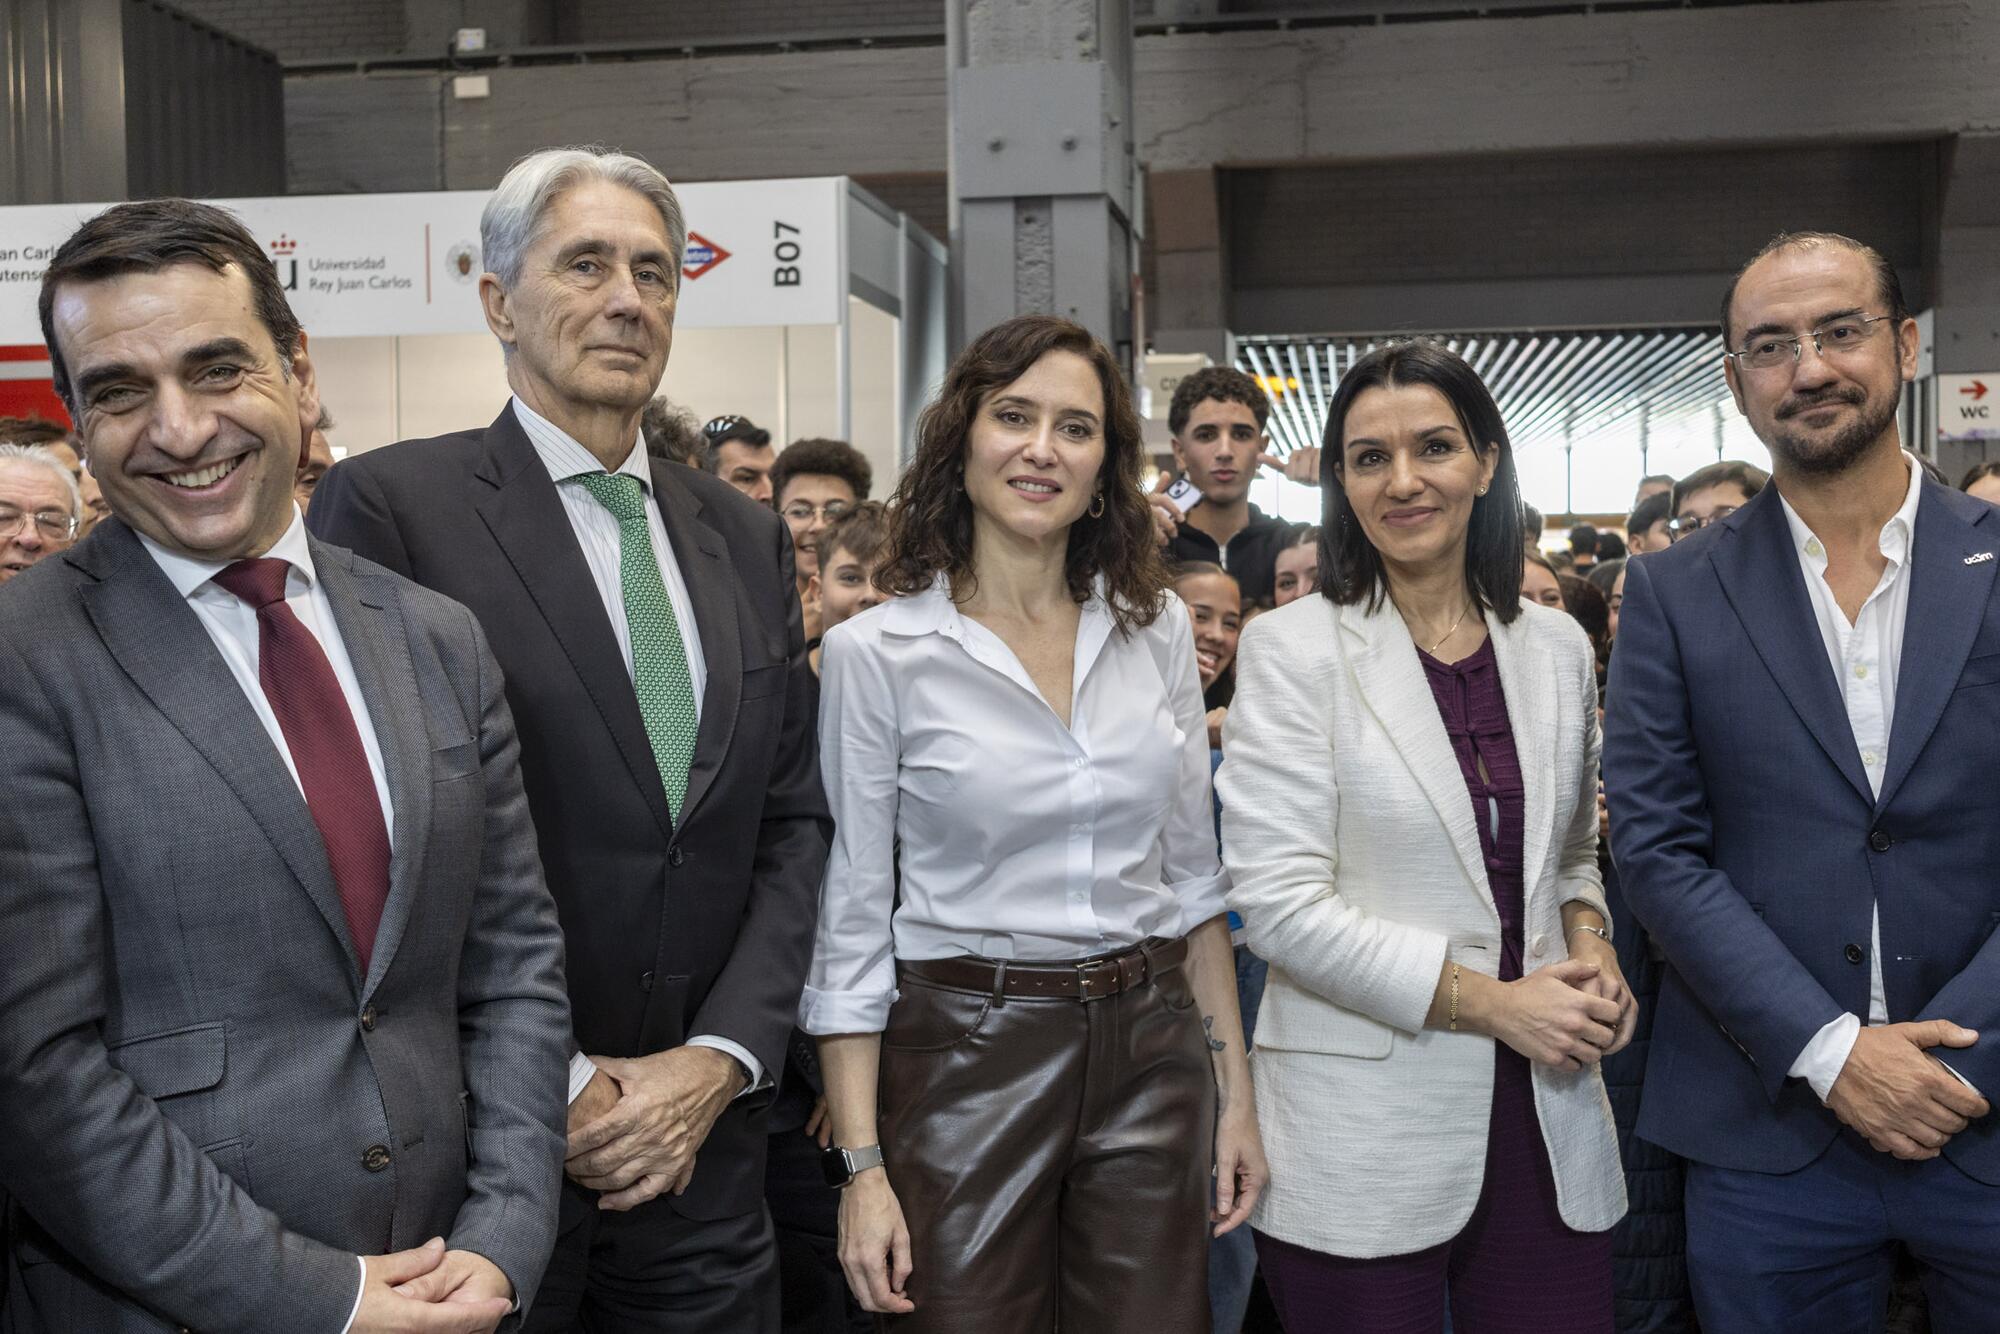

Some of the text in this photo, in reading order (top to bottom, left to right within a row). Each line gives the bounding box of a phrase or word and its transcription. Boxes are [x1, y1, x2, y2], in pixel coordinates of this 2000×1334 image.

[773, 220, 800, 287] B07
[308, 256, 386, 271] Universidad
[309, 275, 412, 294] Rey Juan Carlos
[1959, 405, 1990, 419] WC
